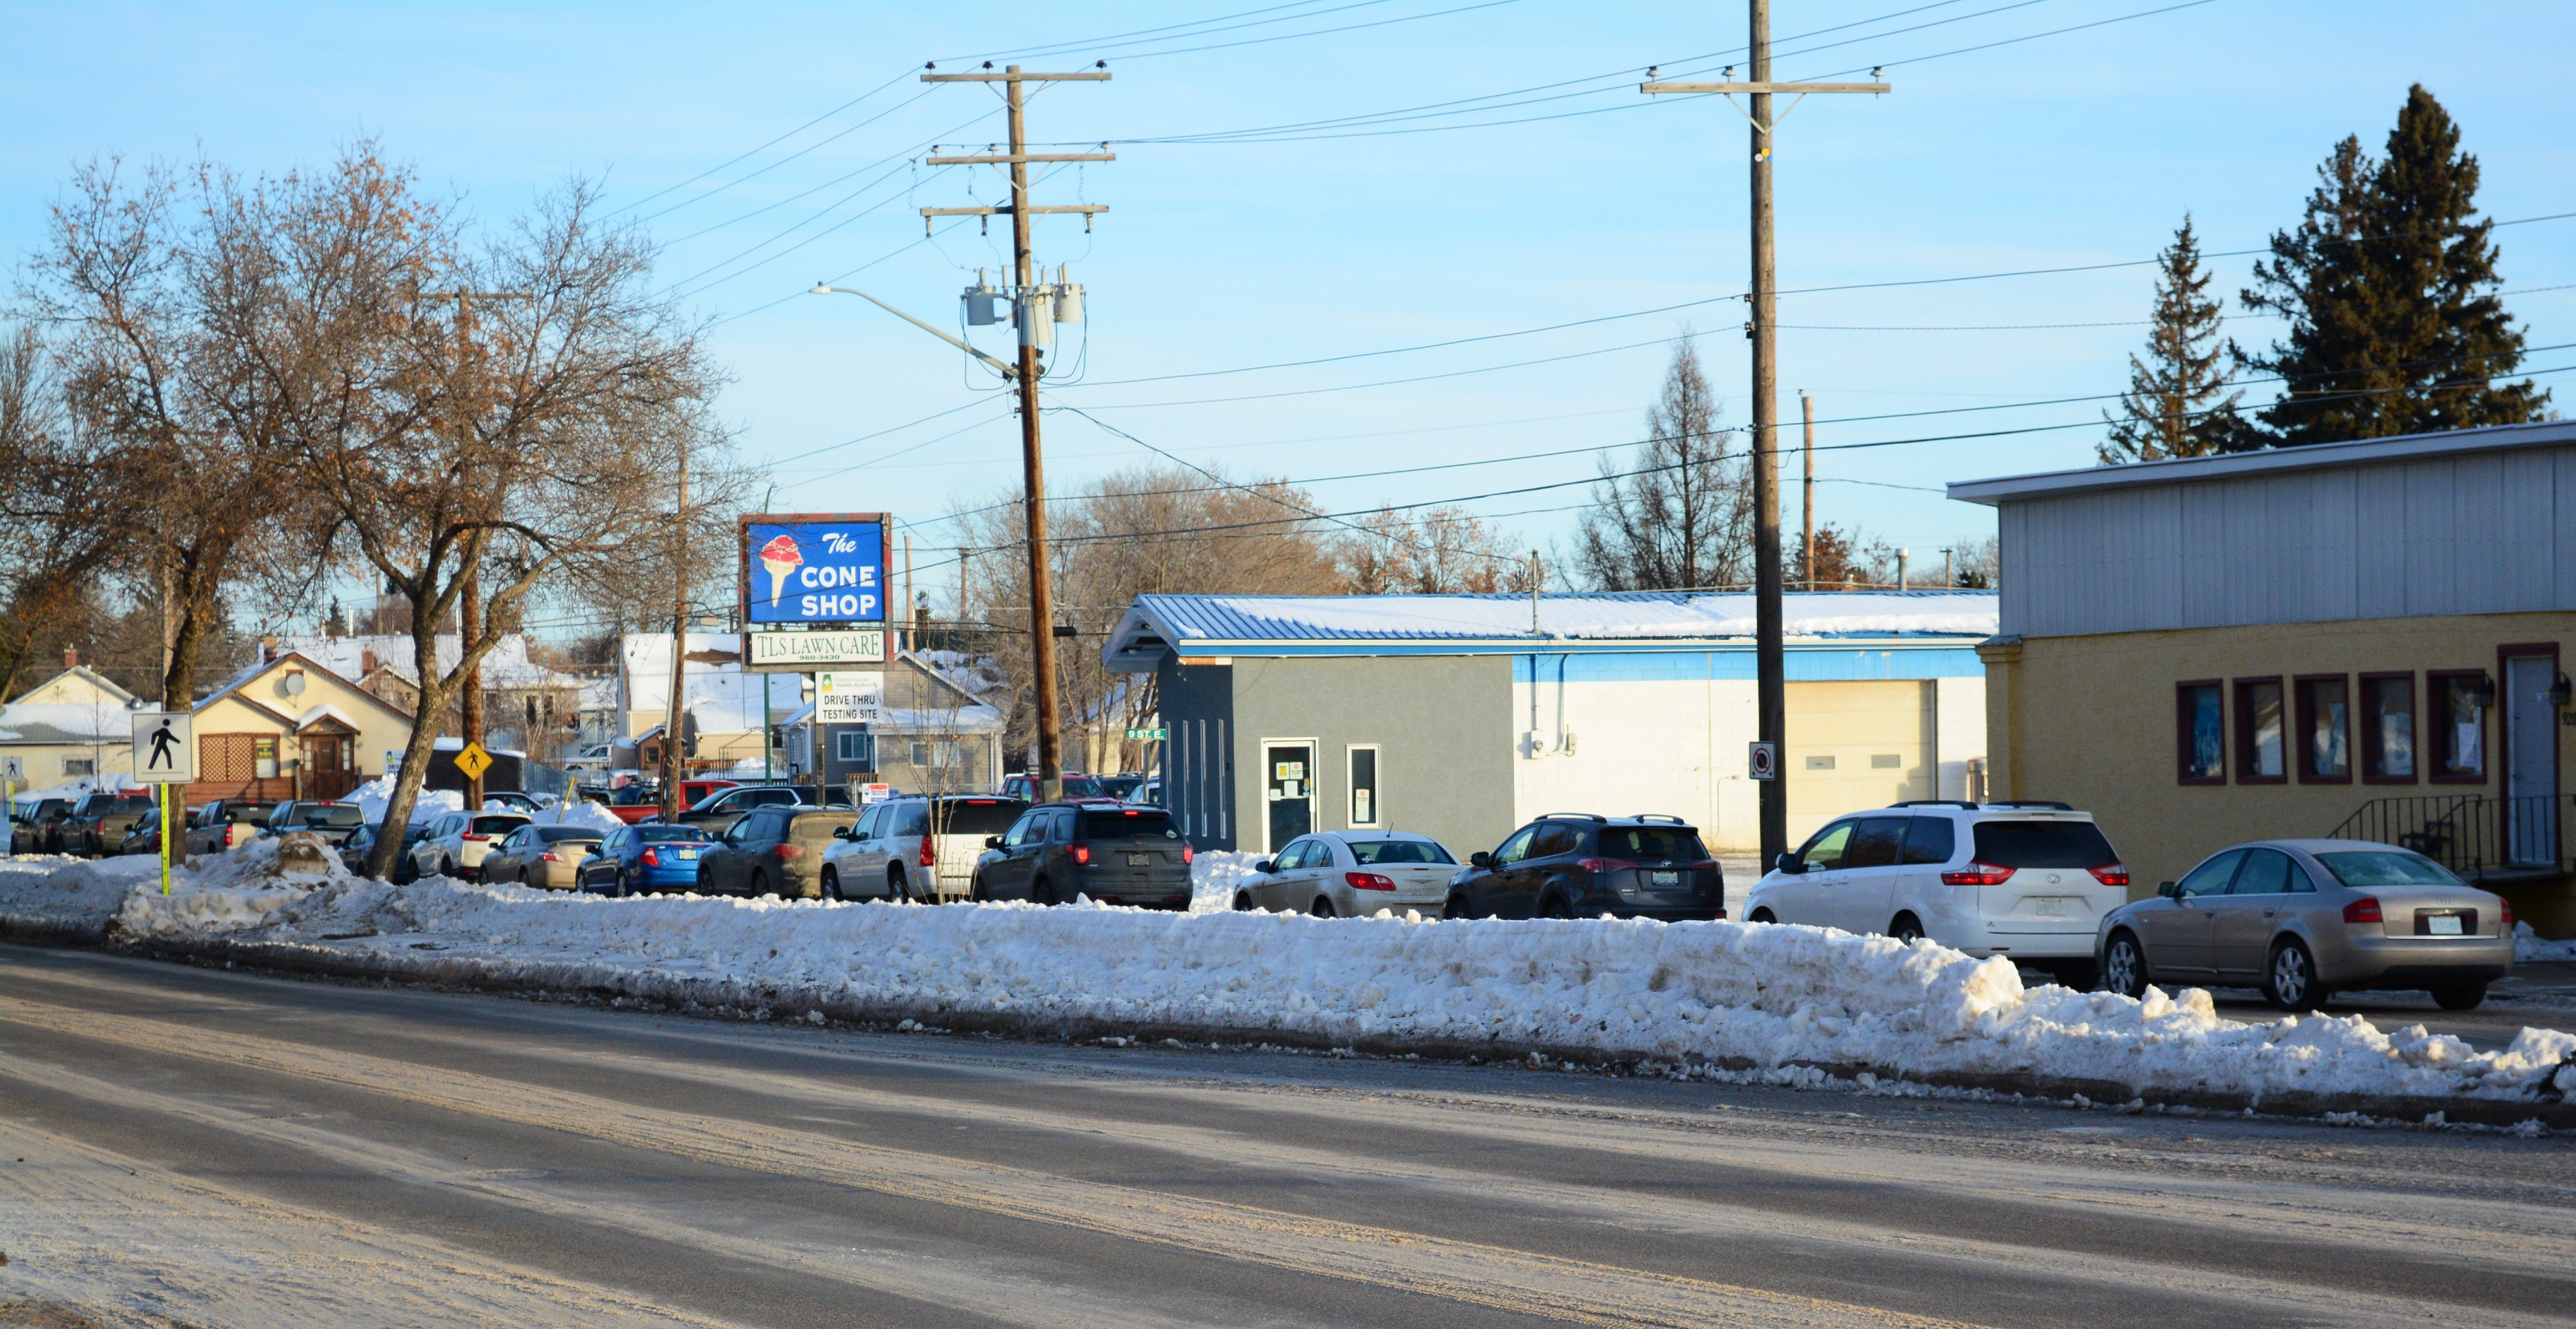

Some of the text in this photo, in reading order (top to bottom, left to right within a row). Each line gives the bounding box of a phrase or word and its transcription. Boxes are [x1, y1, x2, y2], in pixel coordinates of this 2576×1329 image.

[822, 533, 856, 554] The
[801, 566, 875, 588] CONE
[801, 594, 876, 616] SHOP
[758, 633, 880, 658] TLS LAWN CARE
[824, 695, 875, 705] DRIVE THRU
[823, 709, 877, 719] TESTING SITE
[1128, 730, 1164, 738] 9 ST. E.
